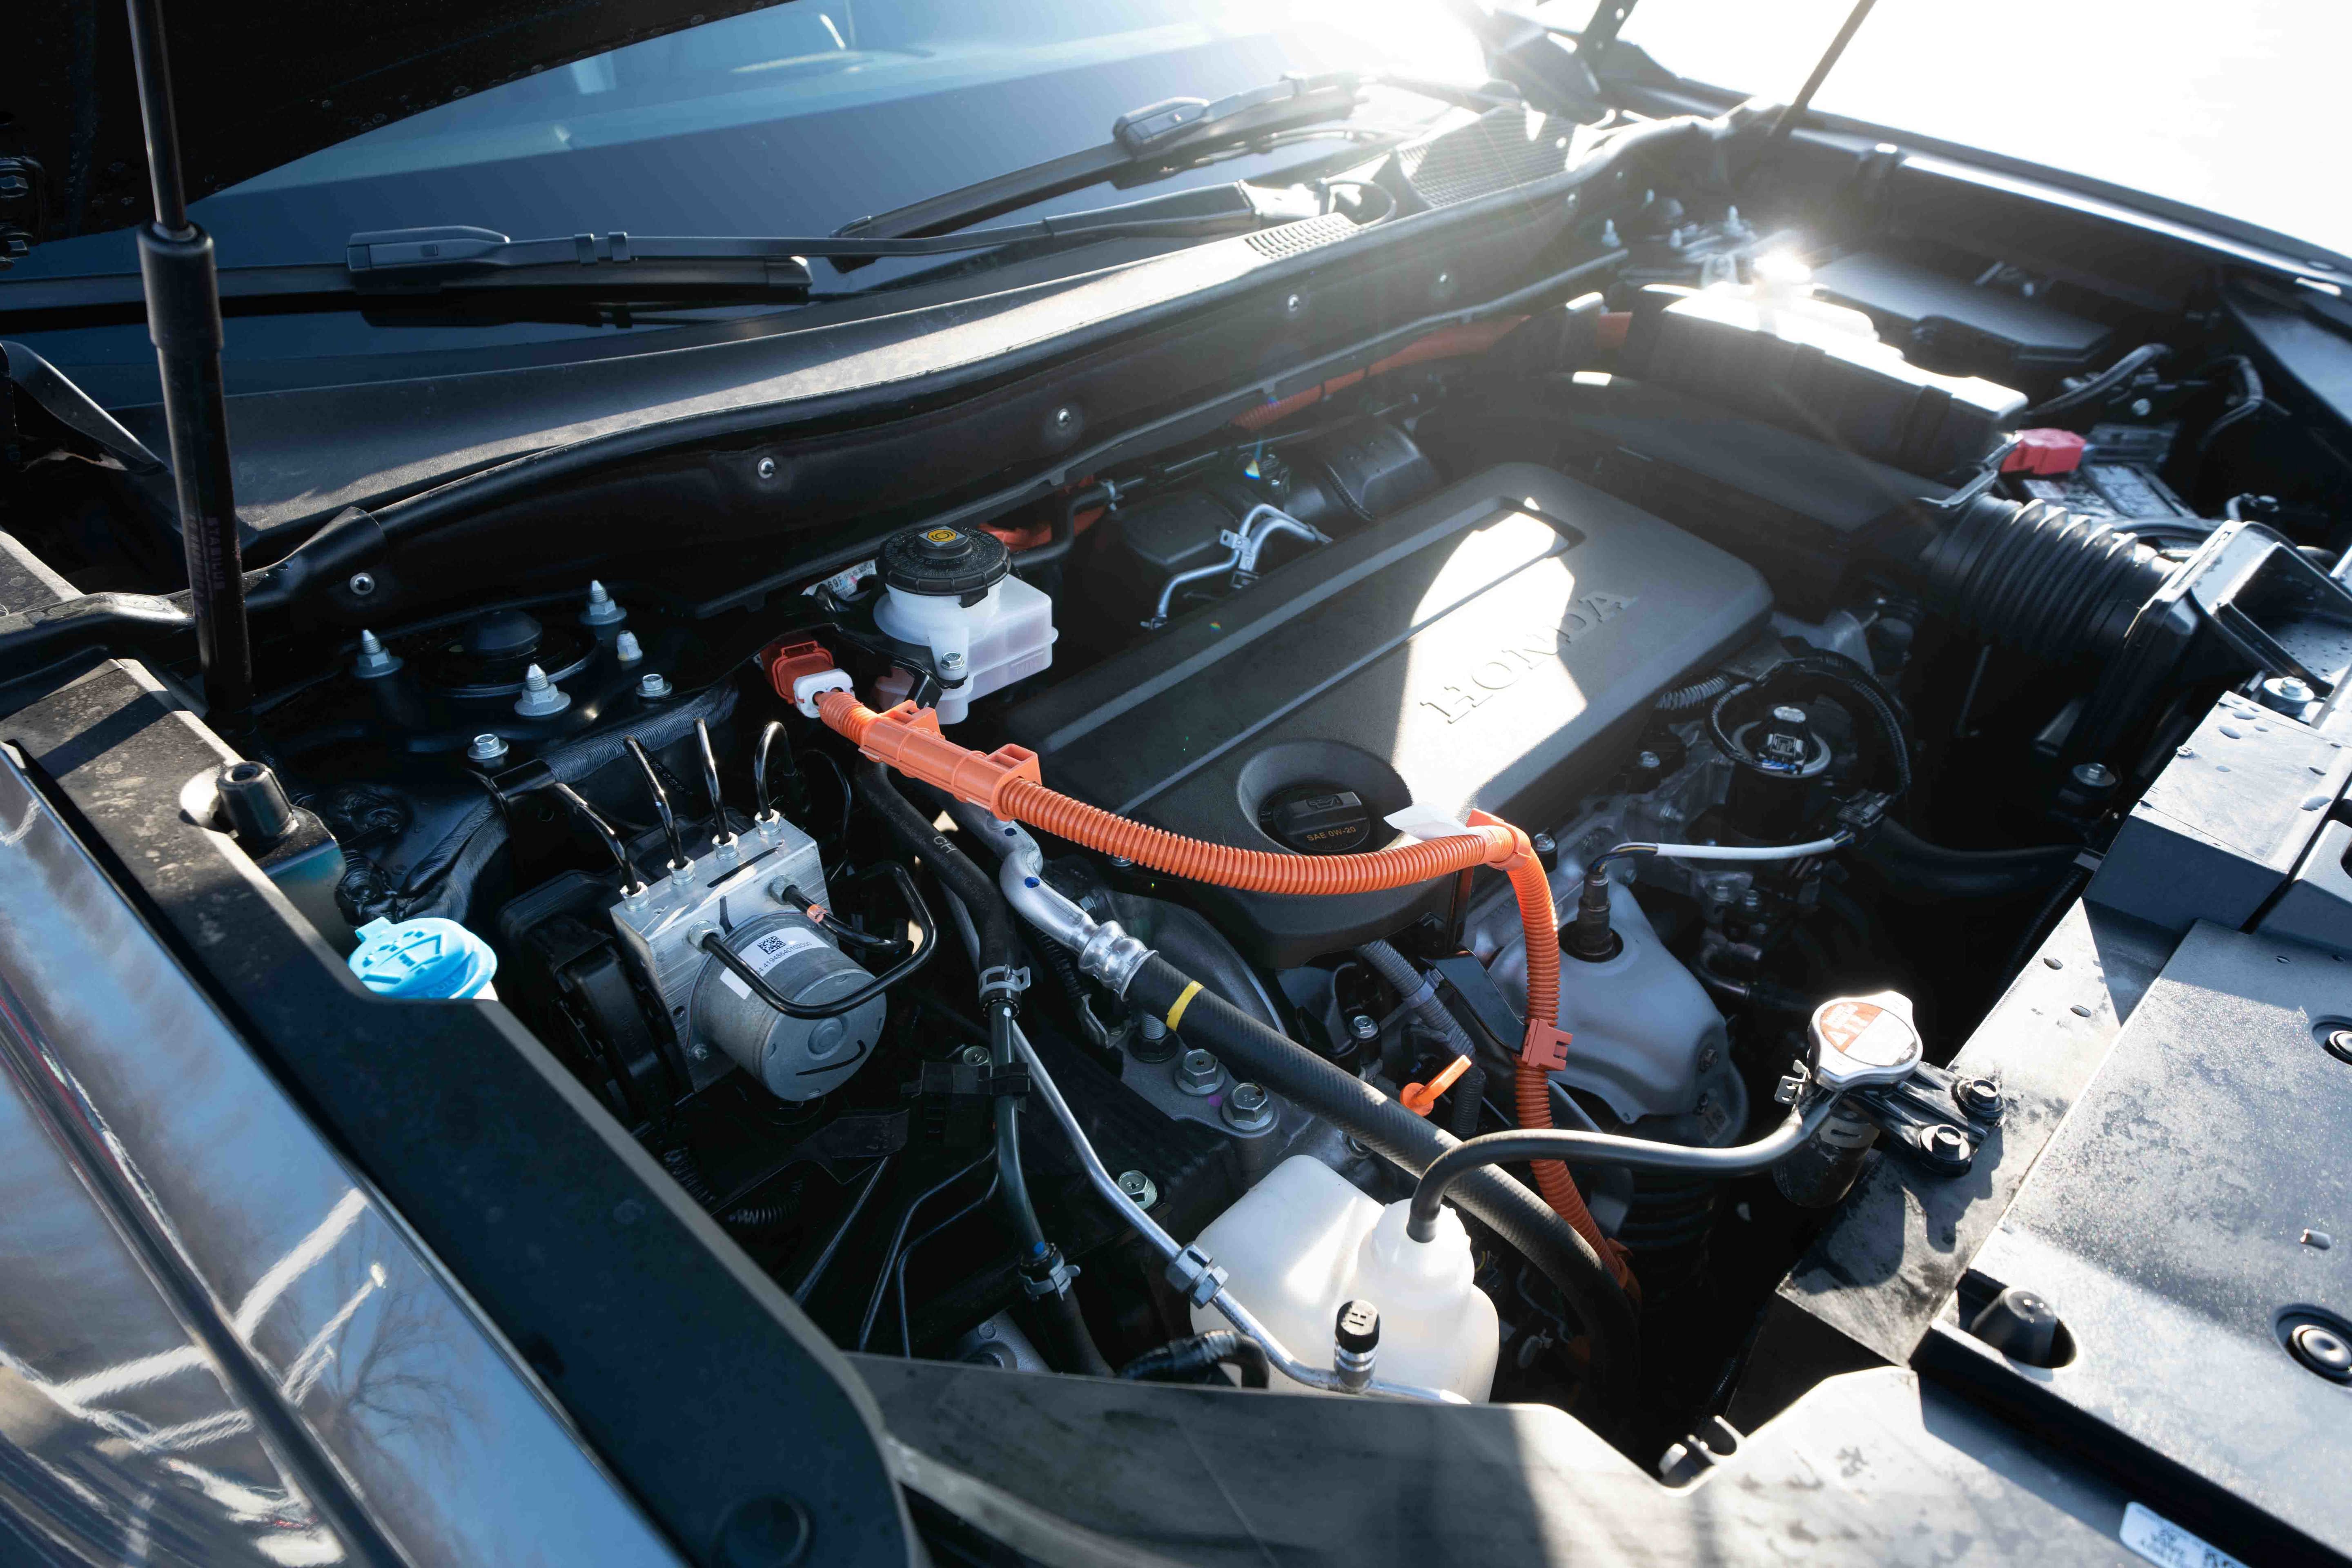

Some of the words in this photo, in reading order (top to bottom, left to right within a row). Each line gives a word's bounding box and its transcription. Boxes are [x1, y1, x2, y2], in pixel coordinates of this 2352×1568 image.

[1420, 591, 1638, 724] HONDA
[1307, 832, 1327, 841] SAE
[1328, 826, 1356, 837] 0W-20
